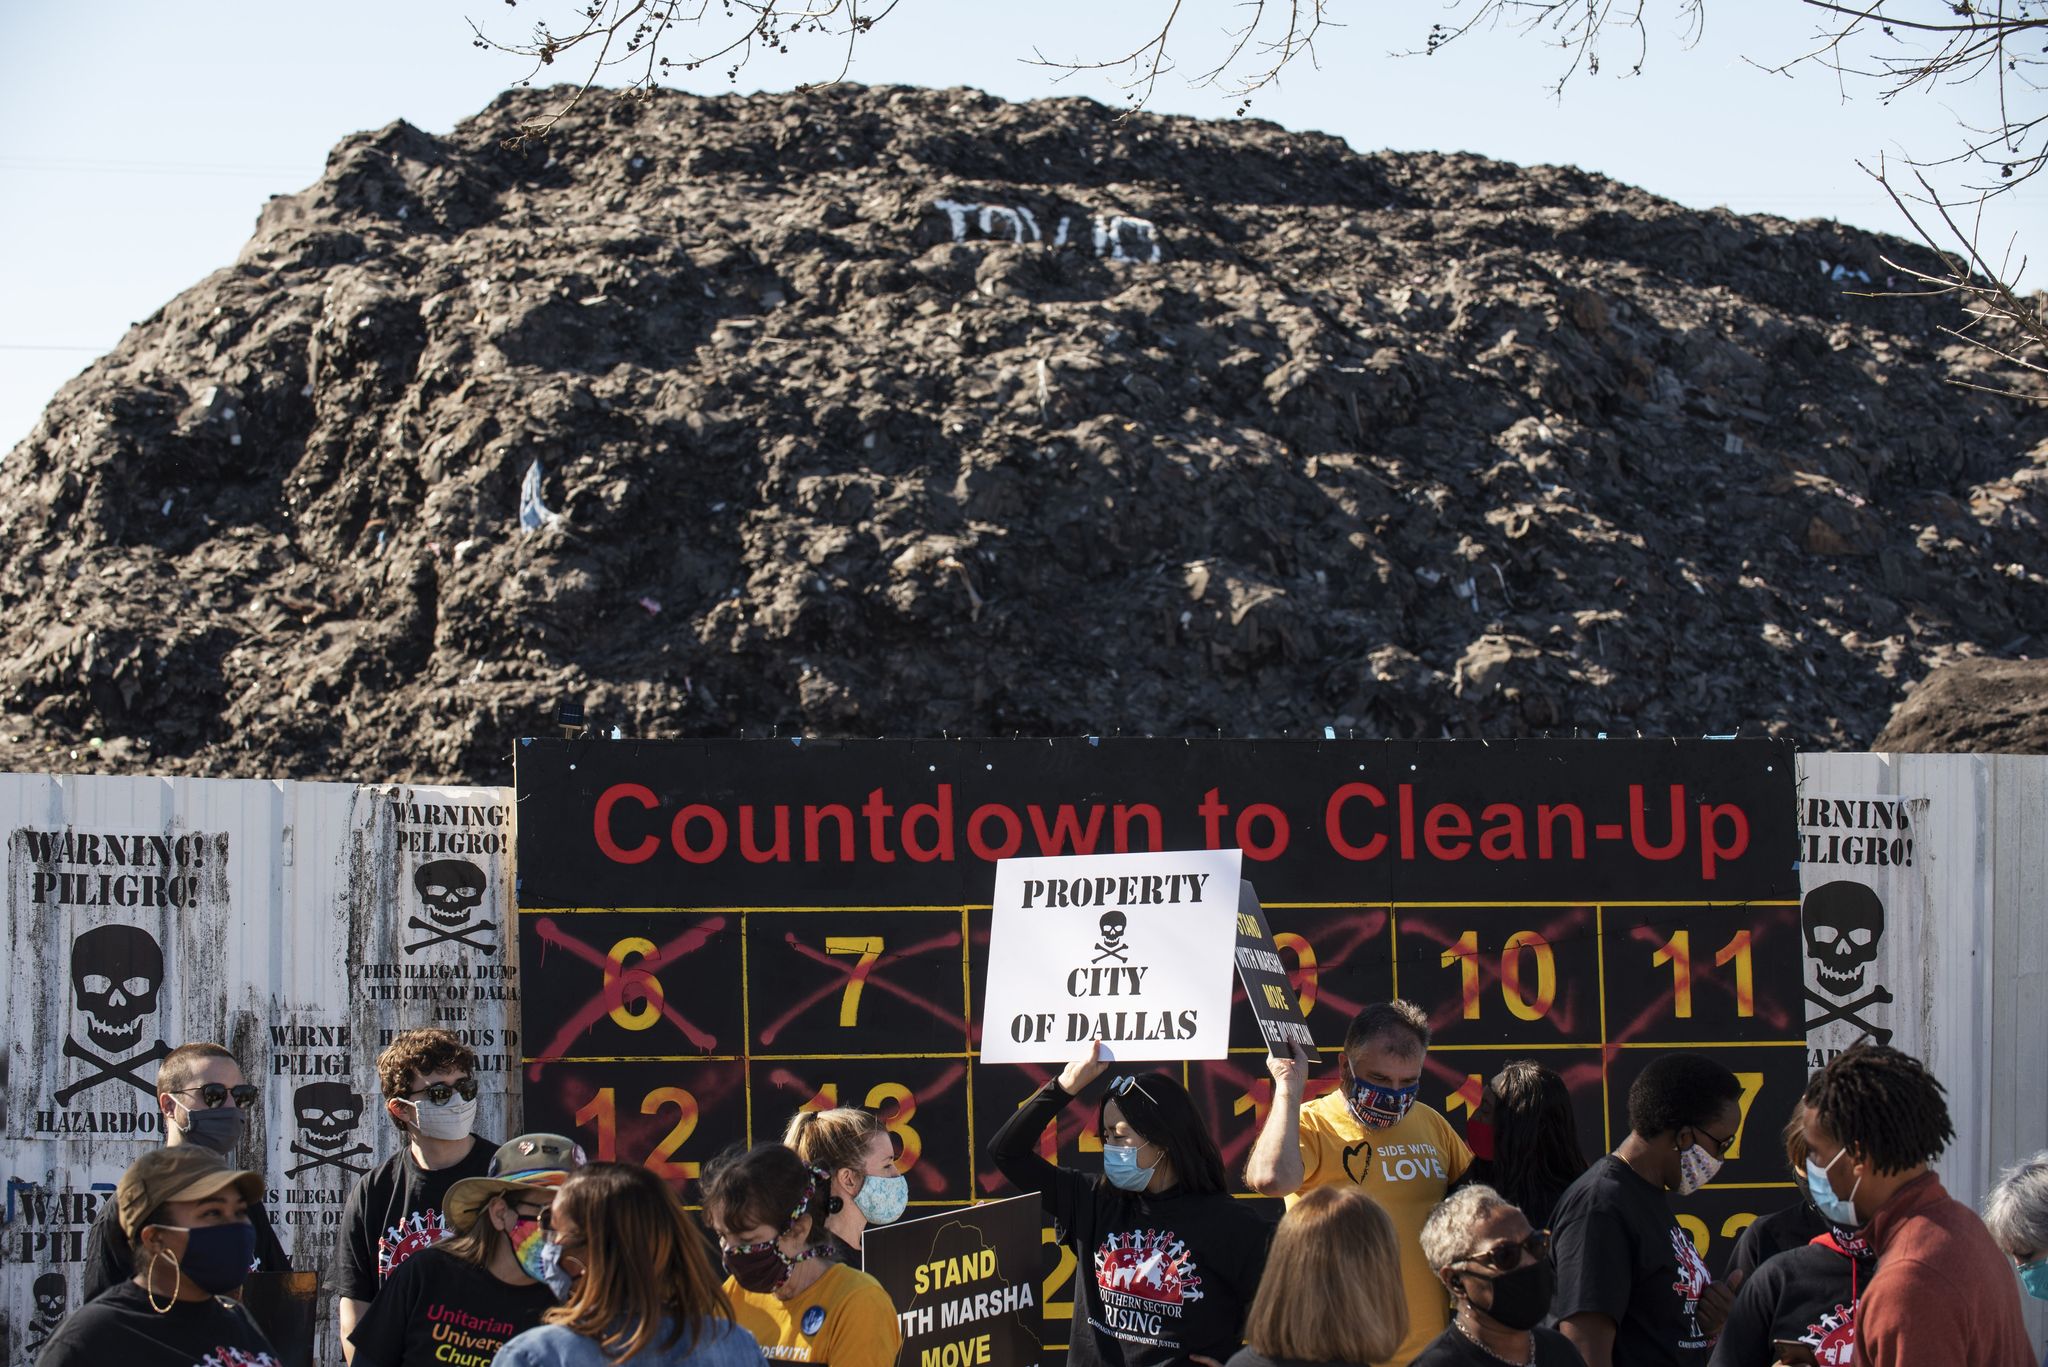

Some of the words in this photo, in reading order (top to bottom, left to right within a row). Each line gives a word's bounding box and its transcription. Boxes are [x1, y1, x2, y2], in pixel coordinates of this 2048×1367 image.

[392, 802, 510, 827] WARNING!
[395, 830, 508, 854] PELIGRO!
[593, 783, 1162, 864] Countdown
[1198, 787, 1290, 862] to
[1326, 782, 1750, 880] Clean-Up
[25, 831, 204, 868] WARNING!
[1021, 873, 1210, 908] PROPERTY
[1237, 912, 1262, 939] STAND
[362, 965, 401, 979] THIS
[404, 964, 471, 979] ILLEGAL
[476, 965, 517, 979] DUMP
[604, 936, 664, 1031] 6
[825, 936, 885, 1027] 7
[1066, 966, 1148, 997] CITY
[1441, 929, 1557, 1022] 10
[1652, 929, 1753, 1018] 11
[403, 985, 439, 1000] CITY
[446, 985, 469, 1000] OF
[1262, 984, 1289, 1010] MOVE
[432, 1007, 467, 1021] ARE
[1010, 1013, 1055, 1043] OF
[1065, 1010, 1198, 1041] DALLAS
[1261, 1019, 1281, 1042] THE
[576, 1087, 700, 1179] 12
[1377, 1145, 1407, 1157] SIDE
[1408, 1144, 1438, 1155] WITH
[1382, 1158, 1449, 1182] LOVE
[914, 1249, 996, 1295] STAND
[897, 1305, 933, 1338] ITH
[940, 1281, 1034, 1329] MARSHA
[1098, 1287, 1141, 1309] OUTHERN
[1143, 1300, 1182, 1318] SECTOR
[427, 1303, 514, 1337] Unitarian
[1104, 1304, 1162, 1336] RISING
[431, 1323, 504, 1353] Univers
[921, 1333, 991, 1367] MOVE
[1118, 1331, 1158, 1346] ENVIRONMENTAL
[1157, 1339, 1181, 1349] JUSTICE
[435, 1344, 491, 1367] Churc
